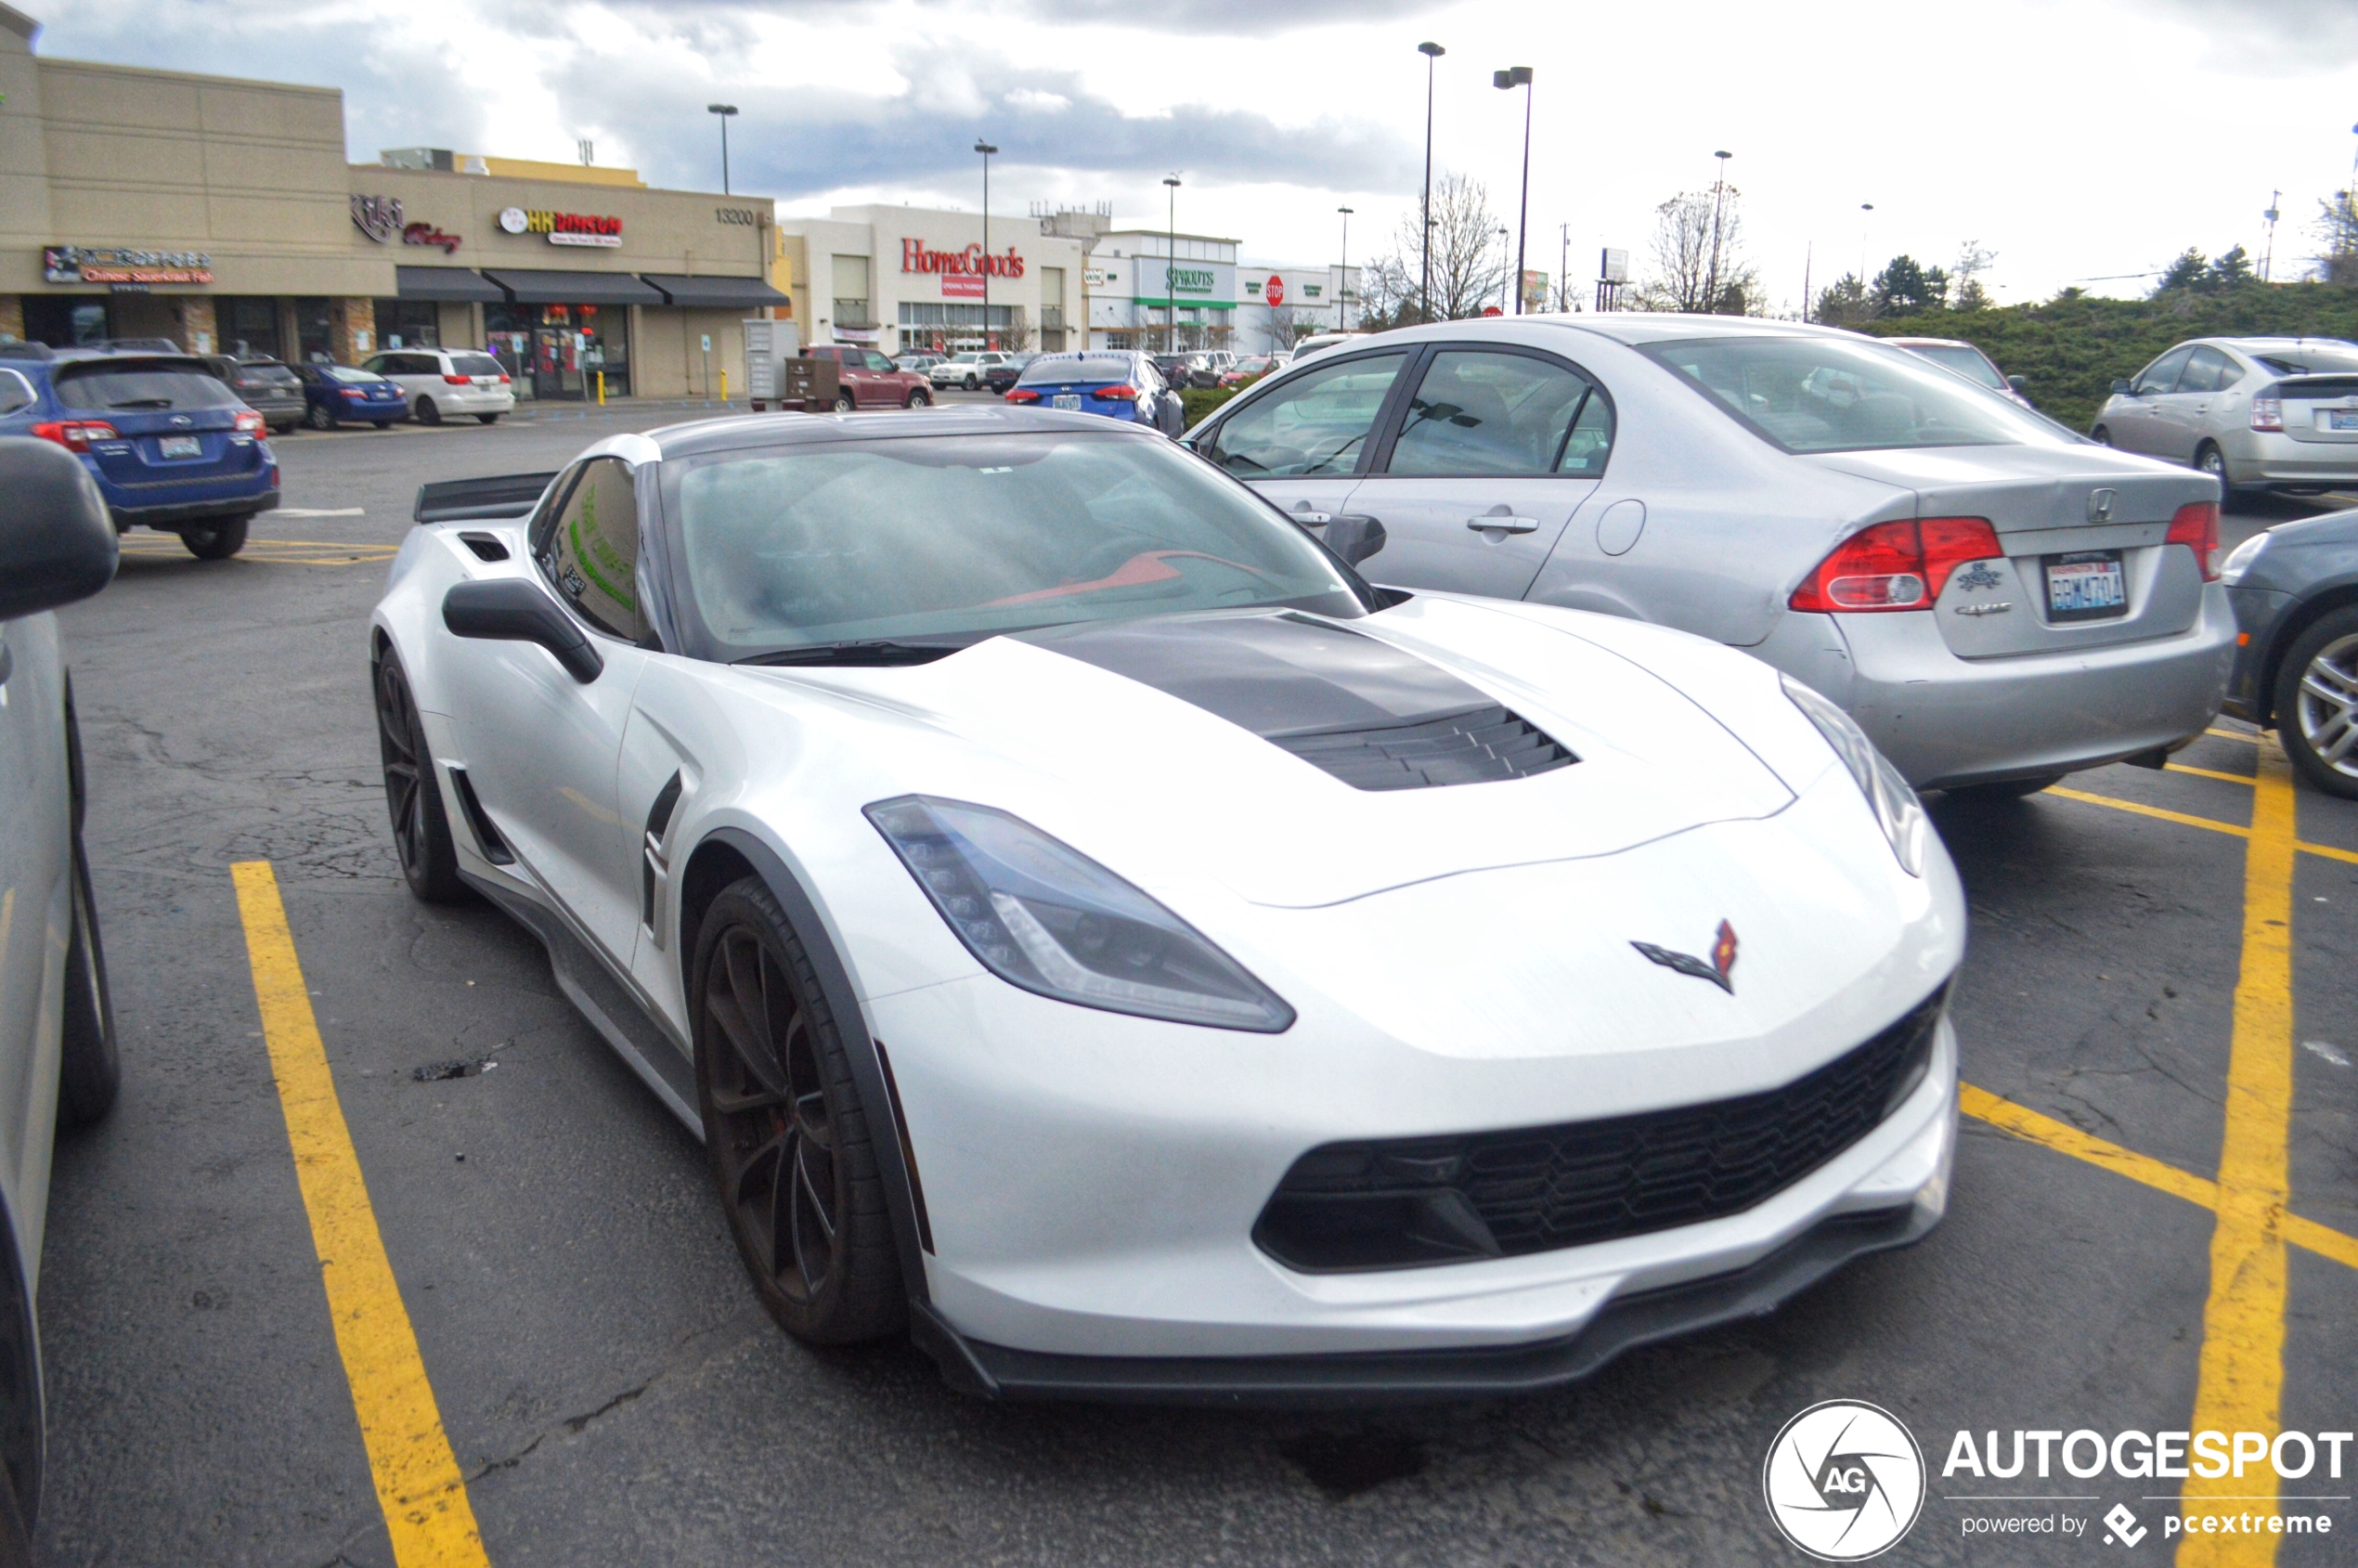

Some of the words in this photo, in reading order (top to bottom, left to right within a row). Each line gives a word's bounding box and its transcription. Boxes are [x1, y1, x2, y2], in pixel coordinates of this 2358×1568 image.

[716, 208, 754, 226] 13200
[901, 238, 1025, 278] HomeGoods
[84, 267, 132, 282] Chinese
[1266, 284, 1283, 298] STOP
